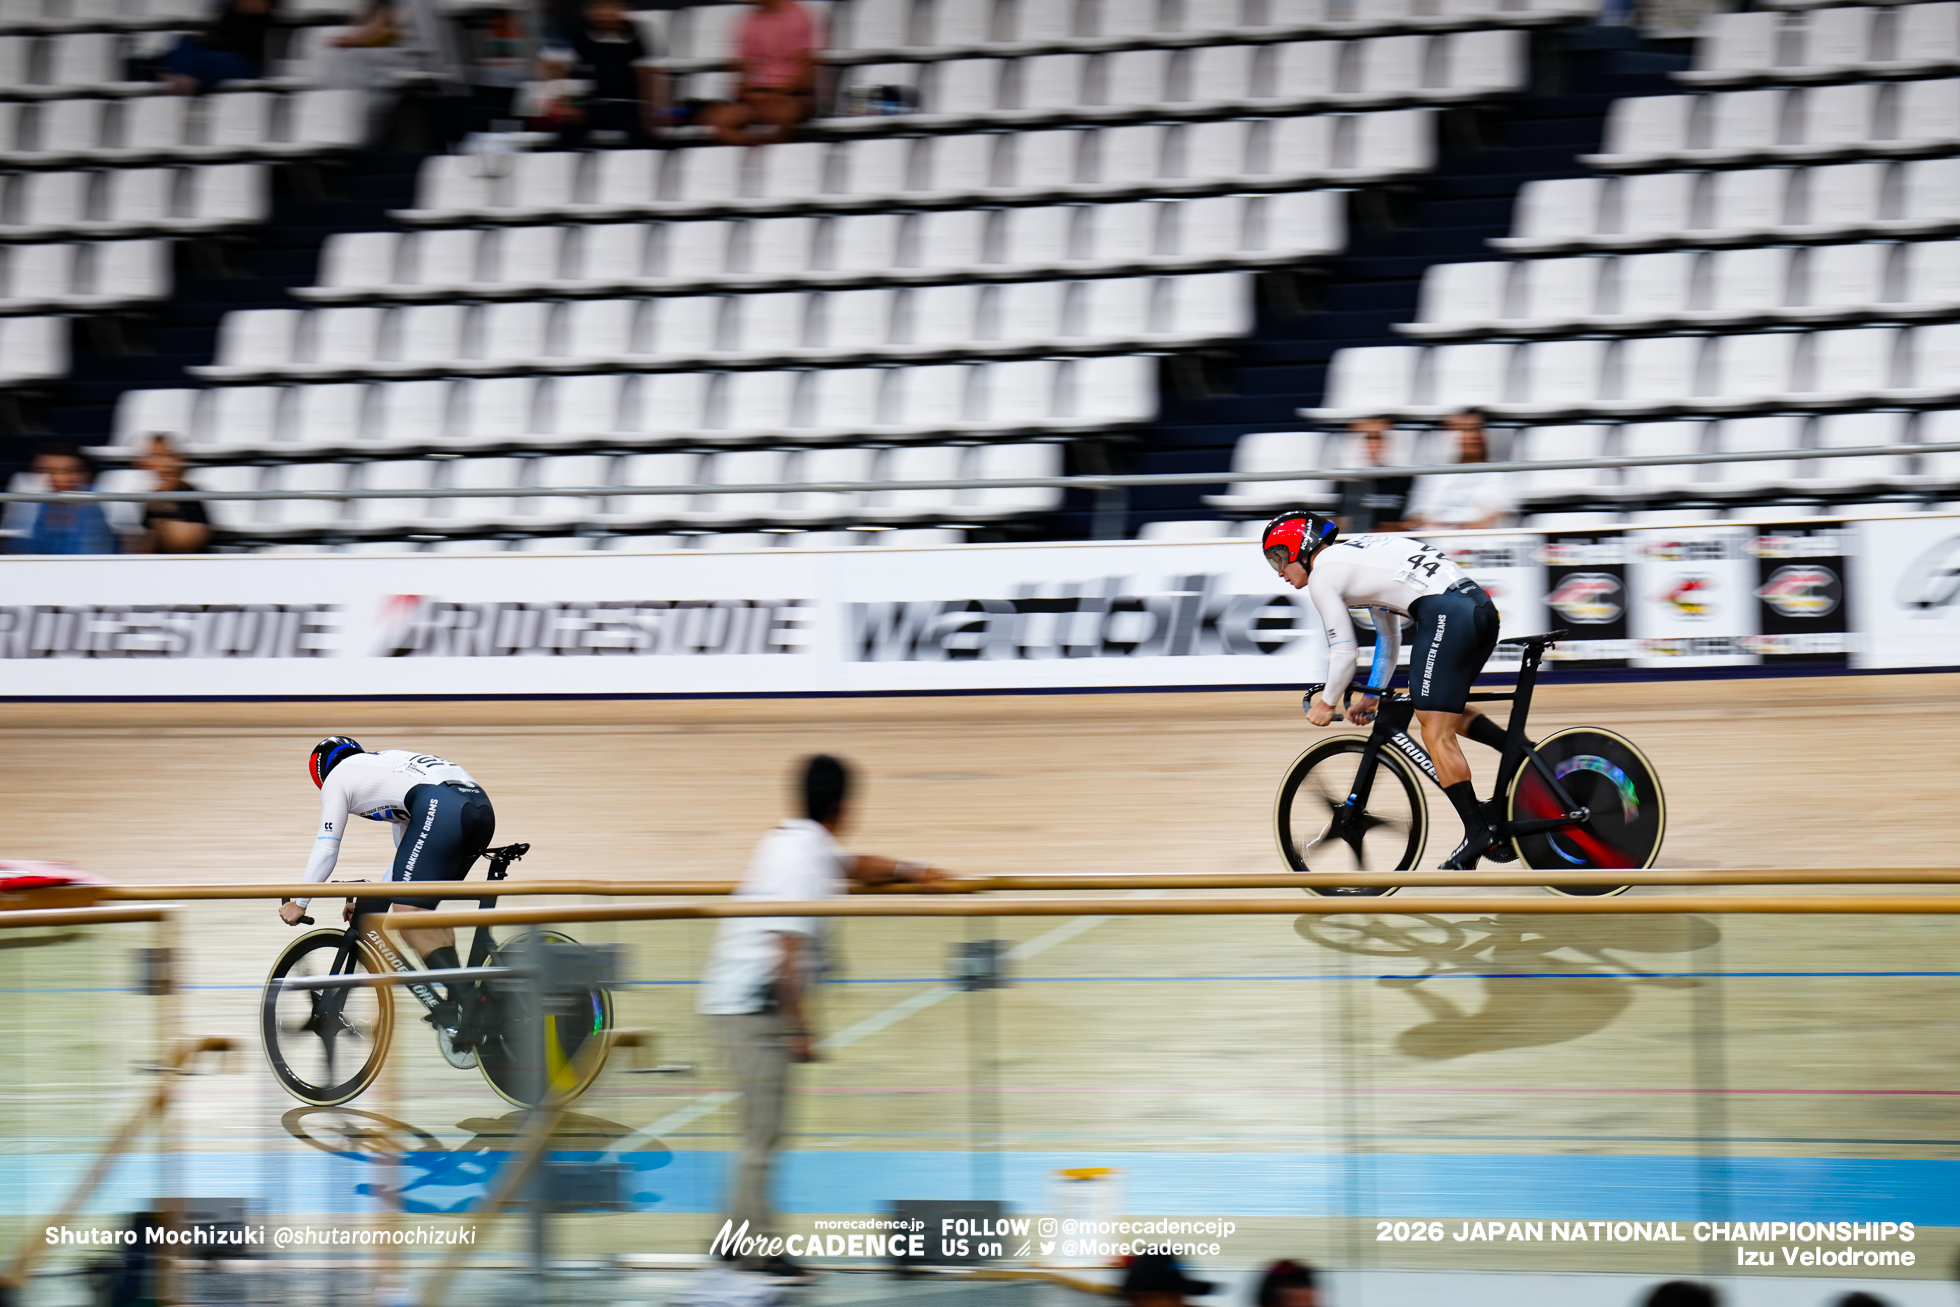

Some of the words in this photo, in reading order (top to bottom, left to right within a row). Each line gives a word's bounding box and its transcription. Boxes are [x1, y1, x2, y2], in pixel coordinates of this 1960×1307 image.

[1407, 554, 1441, 578] 44
[845, 573, 1306, 662] wattbike
[1433, 614, 1447, 642] DREAMS
[1424, 648, 1438, 679] RAKUTEN
[1421, 679, 1431, 697] TEAM
[423, 798, 439, 832] DREAMS
[405, 838, 425, 872] RAKUTEN
[402, 870, 413, 882] AM
